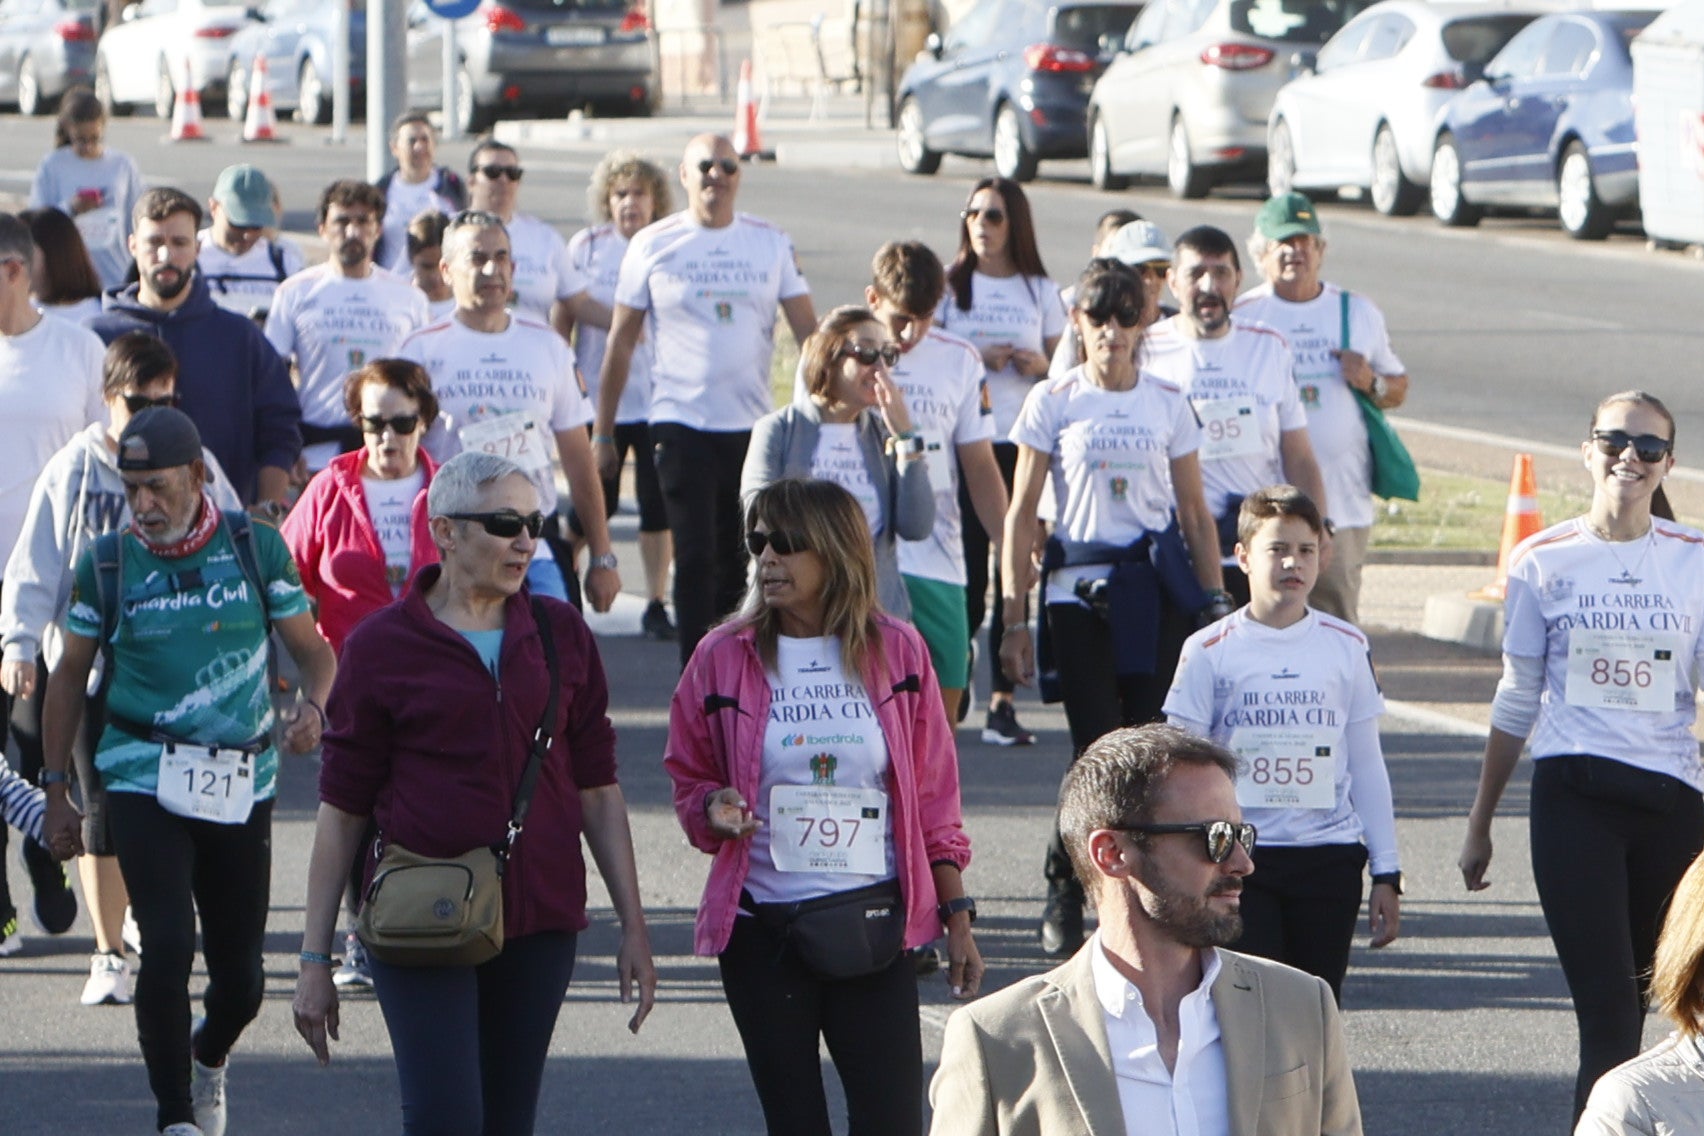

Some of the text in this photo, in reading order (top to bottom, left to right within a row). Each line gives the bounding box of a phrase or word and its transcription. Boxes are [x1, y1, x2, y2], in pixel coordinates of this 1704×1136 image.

[206, 581, 249, 609] Civil
[1578, 593, 1674, 609] III CARRERA
[1556, 611, 1642, 631] GVARDIA
[1590, 657, 1653, 689] 856
[791, 683, 866, 699] CARRERA
[1243, 691, 1260, 706] III
[768, 703, 834, 724] ARDIA
[1224, 708, 1301, 728] GVARDIA
[1252, 757, 1314, 786] 855
[183, 767, 232, 798] 121
[795, 816, 861, 849] 797
